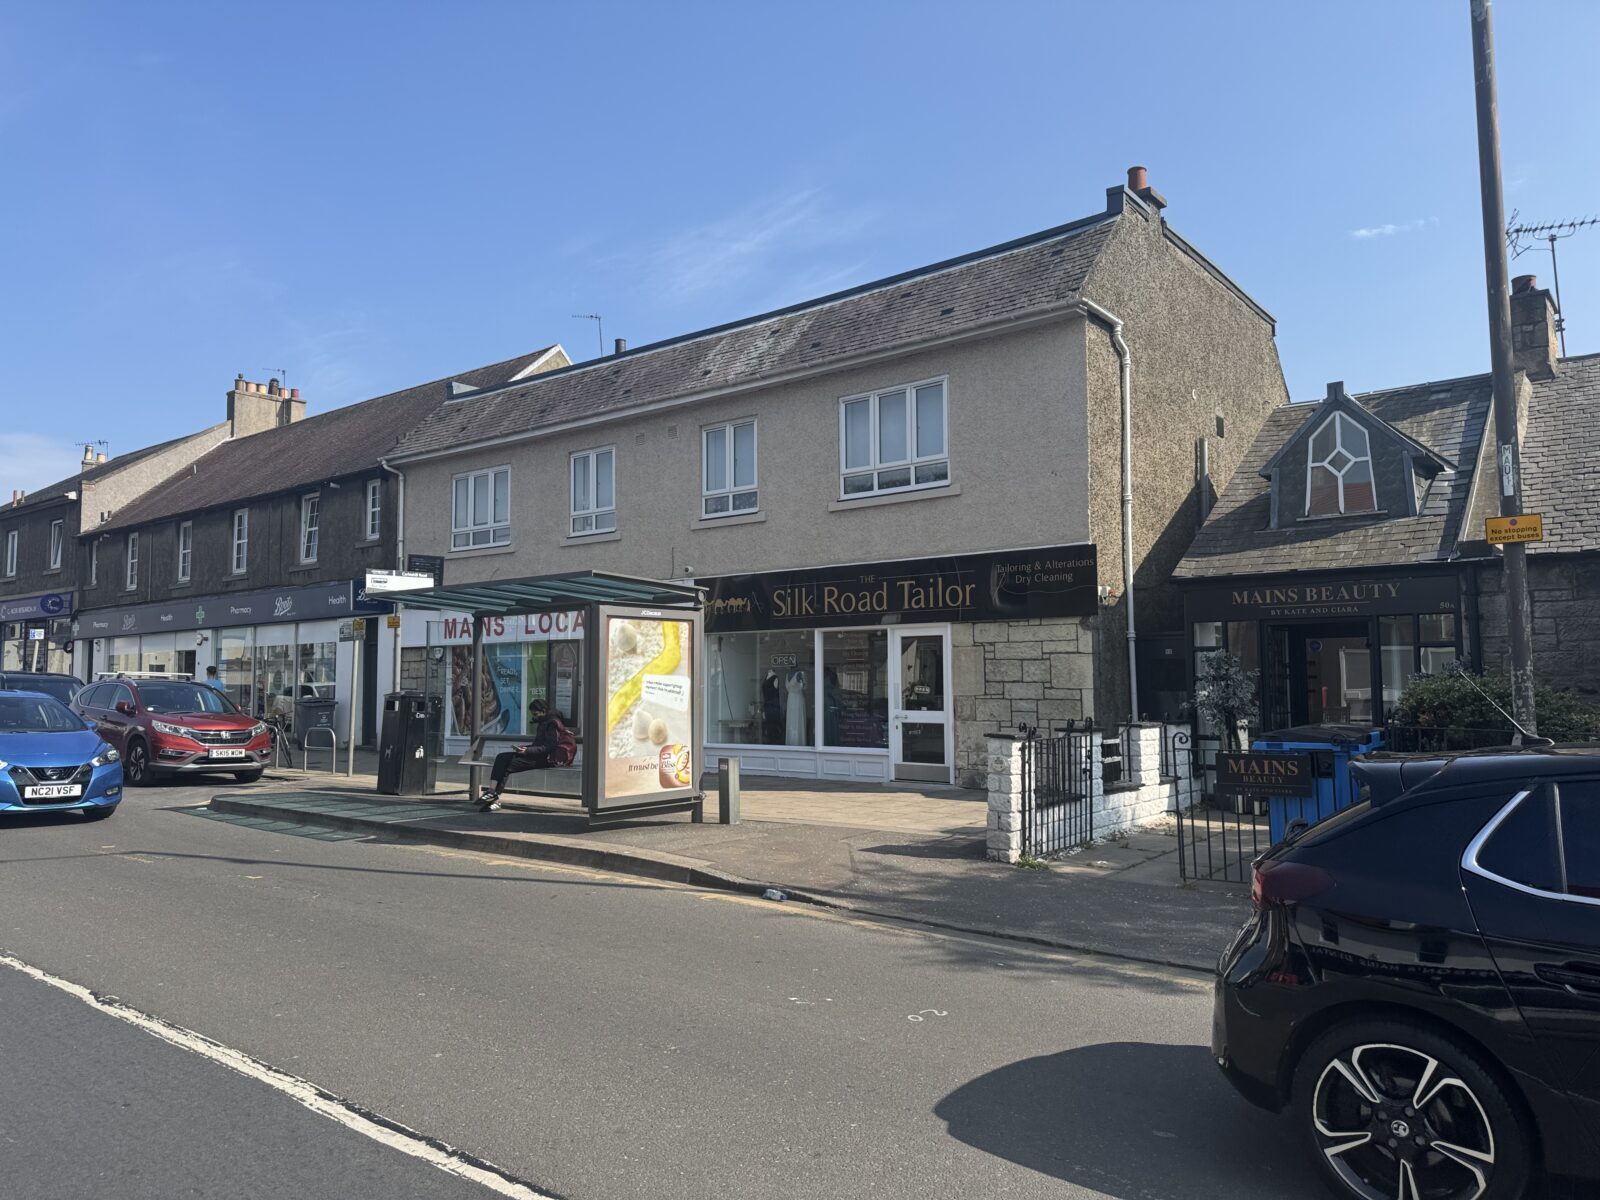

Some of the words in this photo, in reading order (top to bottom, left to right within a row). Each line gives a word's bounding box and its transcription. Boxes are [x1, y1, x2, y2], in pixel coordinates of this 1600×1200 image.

[1504, 526, 1538, 535] stopping
[1489, 534, 1515, 542] except
[996, 562, 1032, 573] Tailoring
[1034, 561, 1042, 570] &
[1045, 559, 1094, 570] Alterations
[860, 575, 875, 584] THE
[1015, 574, 1032, 585] Dry
[1034, 572, 1073, 583] Cleaning
[773, 587, 815, 617] Silk
[824, 582, 888, 614] Road
[897, 577, 976, 609] Tailor
[1232, 587, 1298, 605] MAINS
[1305, 582, 1401, 602] BEAUTY
[328, 595, 346, 605] Health
[230, 606, 252, 615] Pharmacy
[273, 596, 293, 617] Boots
[1310, 606, 1328, 614] AND
[1331, 605, 1359, 613] CIARA
[444, 616, 504, 639] MANS
[773, 656, 796, 665] OPEN
[633, 763, 650, 771] must
[1228, 759, 1298, 776] MAINS
[1243, 775, 1284, 784] BEAUTY
[31, 786, 54, 796] NC21
[57, 785, 75, 795] VSF
